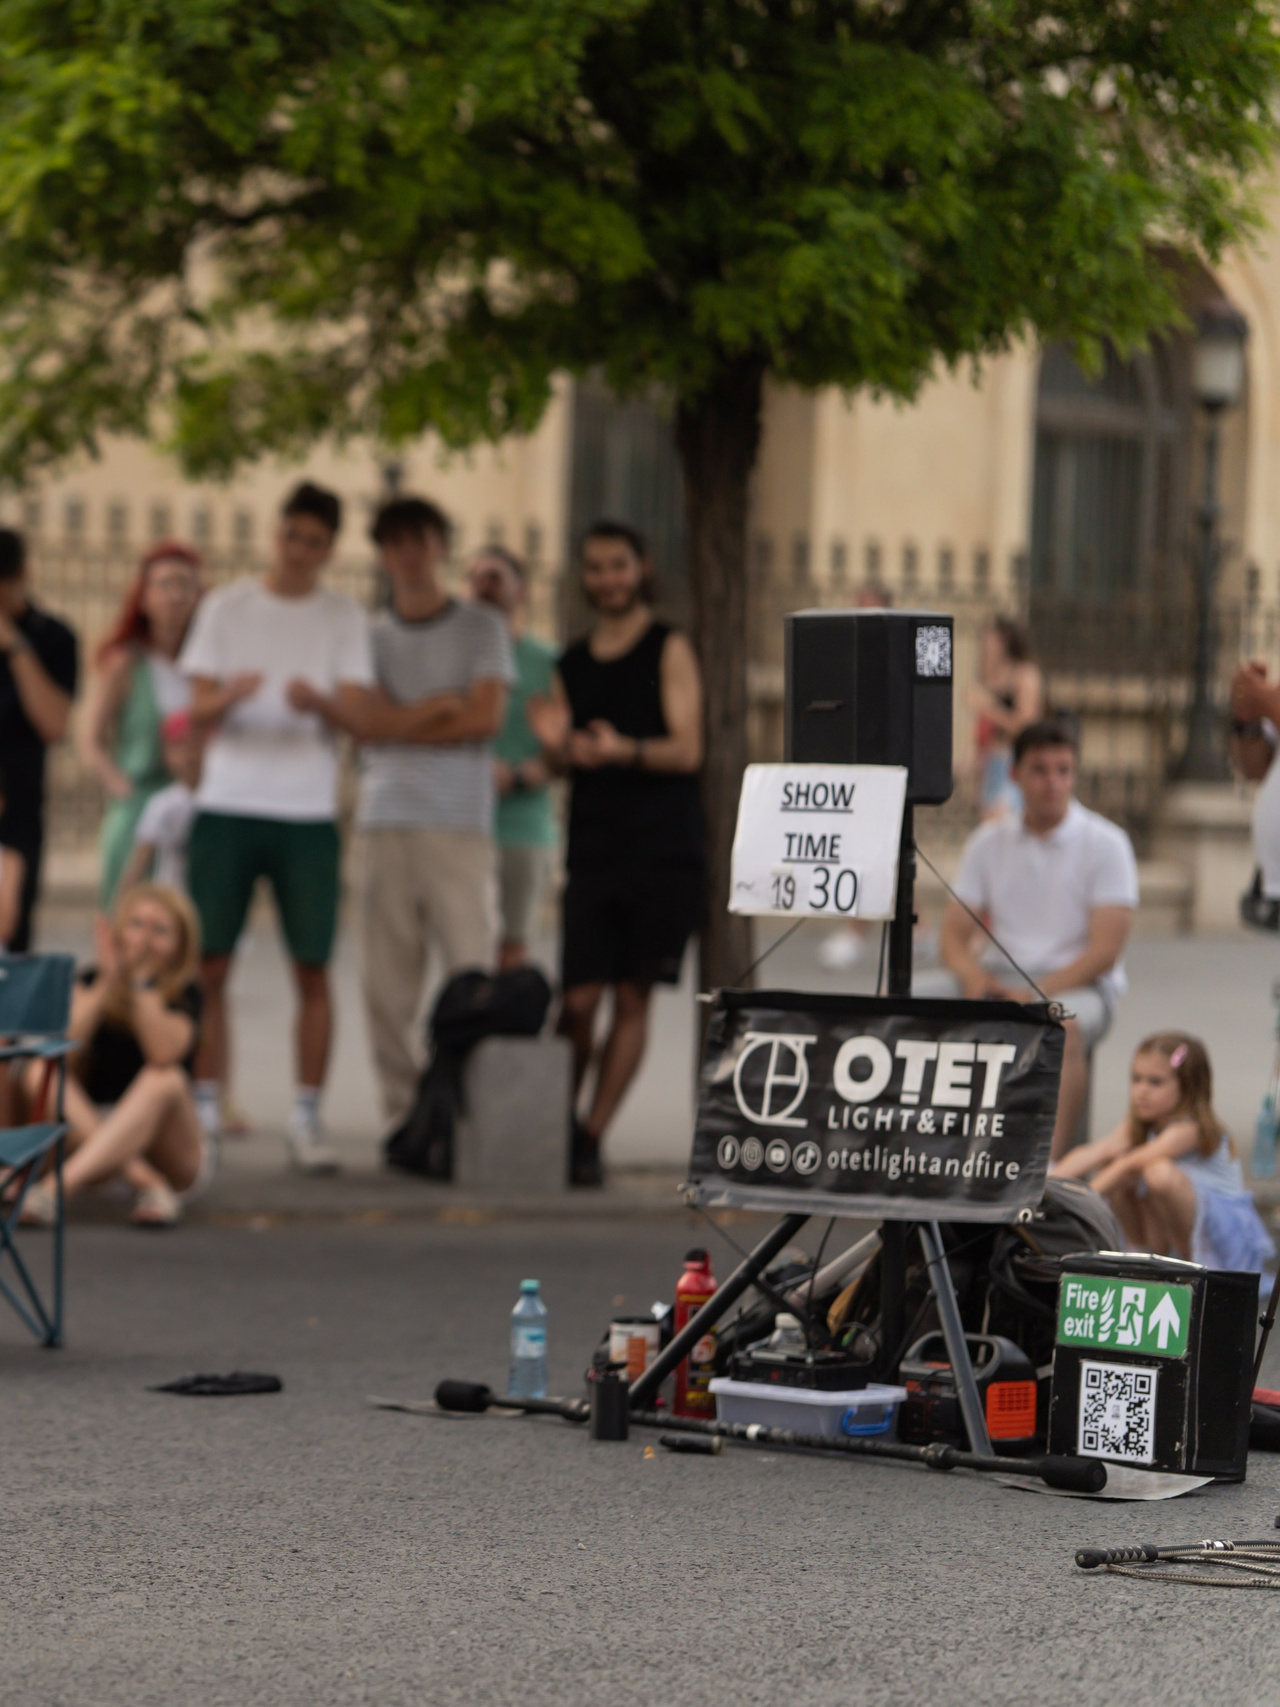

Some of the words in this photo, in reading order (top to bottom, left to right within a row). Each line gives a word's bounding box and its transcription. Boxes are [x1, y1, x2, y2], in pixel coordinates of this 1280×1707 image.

[781, 781, 855, 808] SHOW
[784, 832, 841, 859] TIME
[808, 866, 858, 912] 30
[833, 1036, 1017, 1108] OTET
[828, 1105, 1005, 1137] LIGHT&FIRE
[827, 1145, 1020, 1181] otetlightandfire
[1066, 1283, 1099, 1310] Fire
[1064, 1312, 1095, 1339] exit
